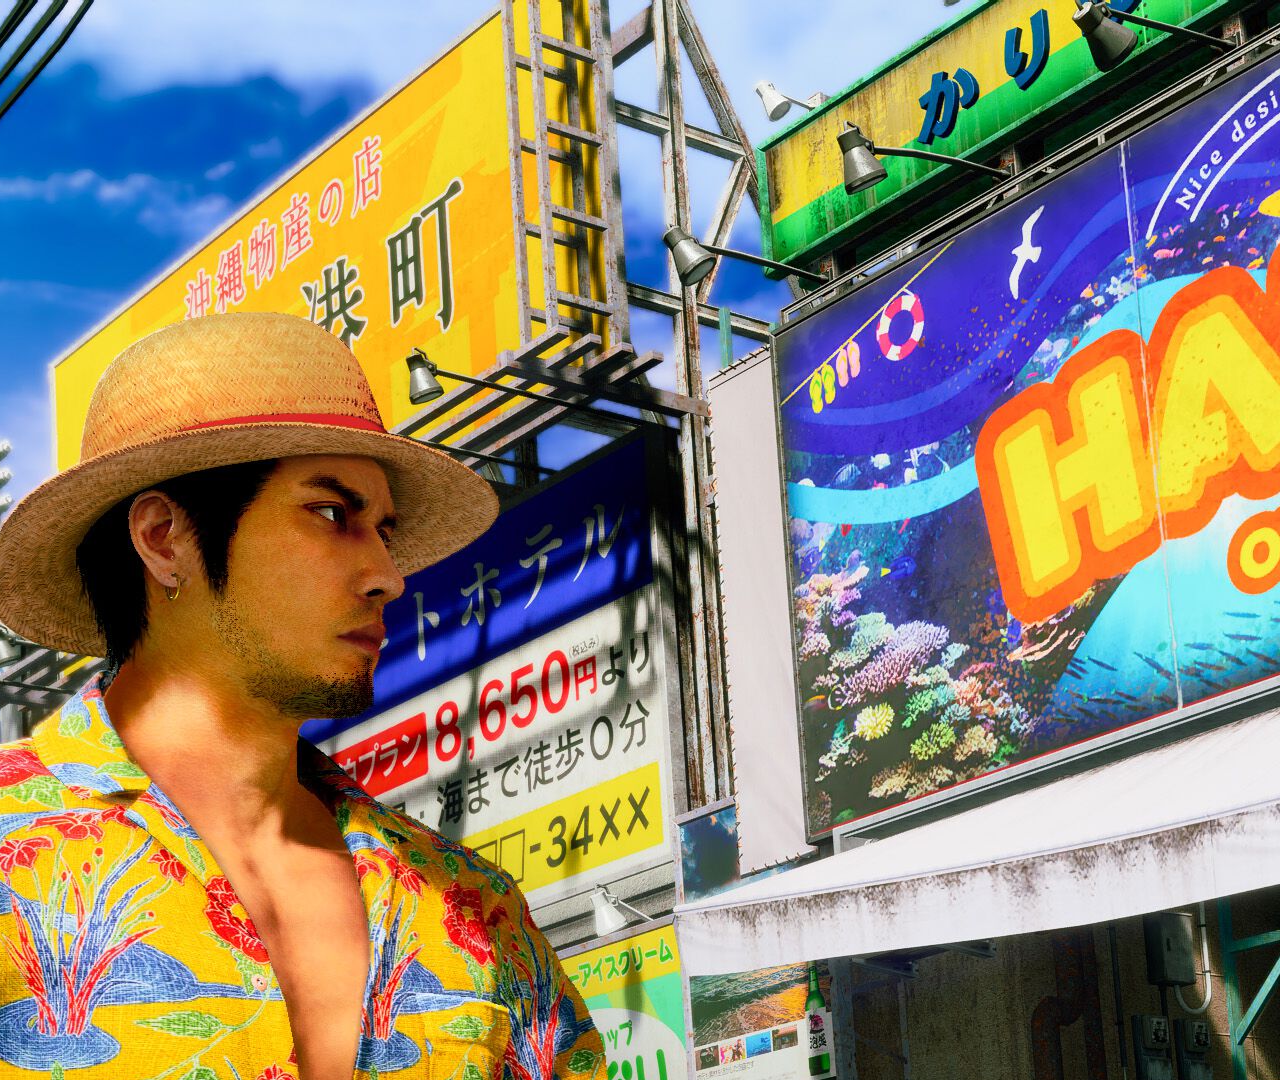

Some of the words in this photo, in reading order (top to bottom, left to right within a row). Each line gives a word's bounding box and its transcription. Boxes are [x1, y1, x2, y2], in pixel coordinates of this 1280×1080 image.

[917, 0, 1140, 145] かり
[185, 136, 382, 321] 沖縄物産の店
[1176, 149, 1223, 211] Nice
[378, 503, 626, 662] トホテル
